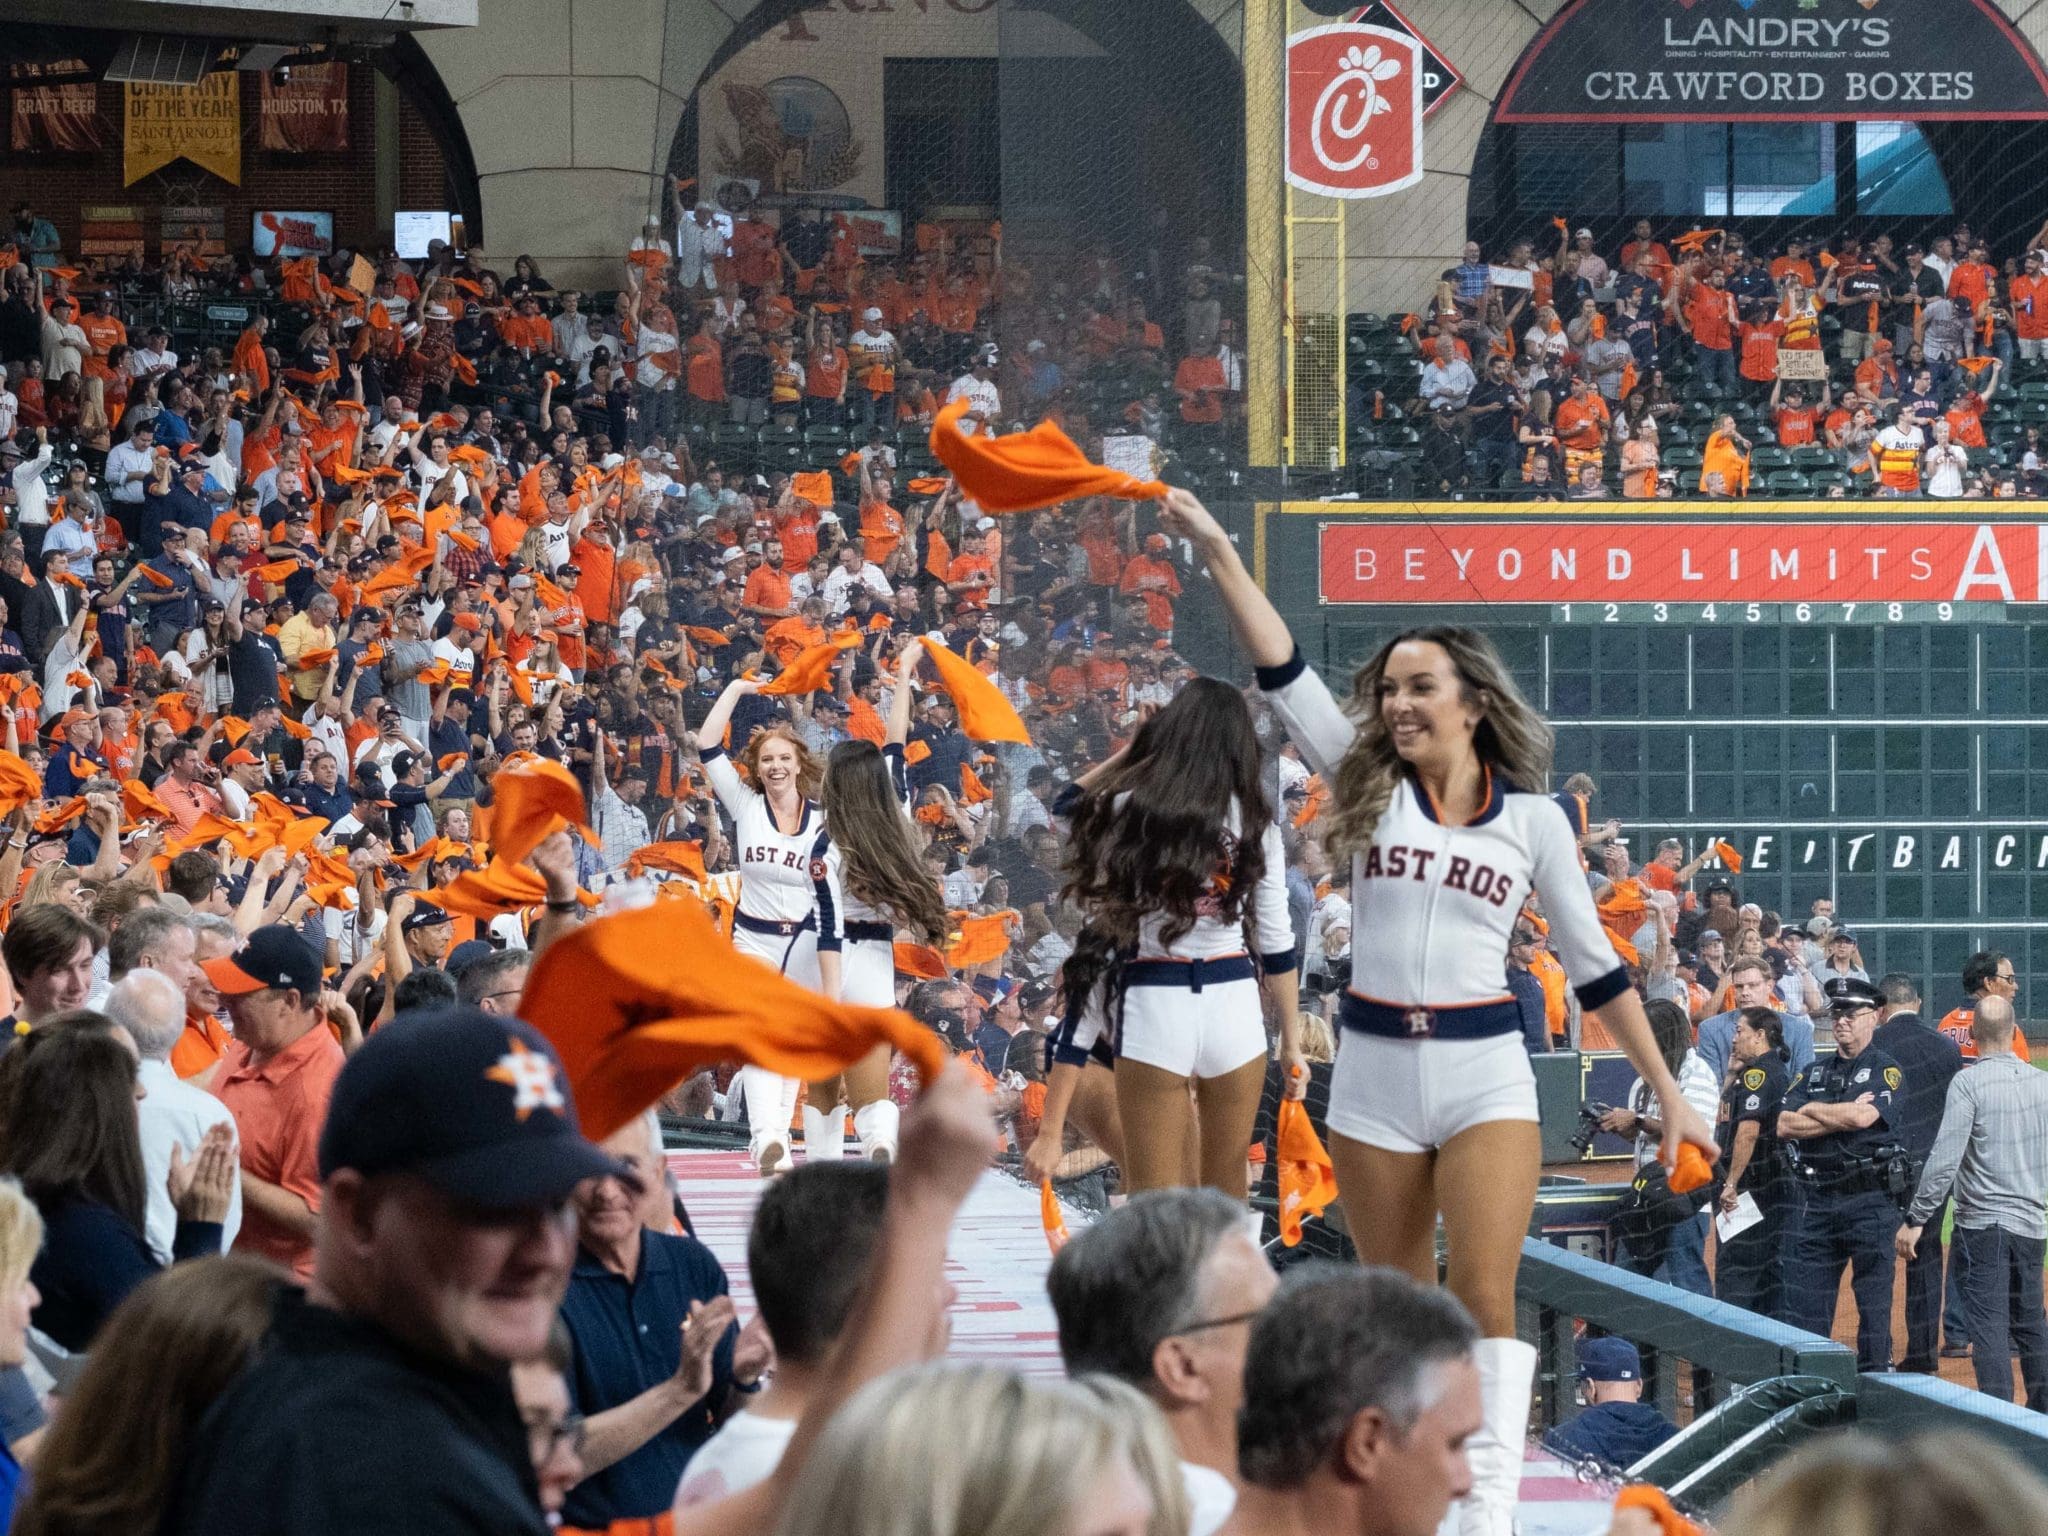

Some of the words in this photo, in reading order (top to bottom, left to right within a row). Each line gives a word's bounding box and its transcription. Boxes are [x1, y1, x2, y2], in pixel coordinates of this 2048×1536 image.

[1665, 17, 1890, 47] LANDRY'S
[1665, 51, 1697, 59] DINING
[1704, 51, 1762, 59] HOSPITALITY
[1771, 51, 1847, 59] ENTERTAINMENT
[1854, 51, 1890, 59] GAMING
[1585, 71, 1825, 101] CRAWFORD
[1845, 71, 1974, 101] BOXES
[17, 99, 60, 114] CRAFT
[62, 99, 96, 114] BEER
[131, 100, 150, 118] OF
[154, 100, 186, 118] THE
[189, 100, 233, 118] YEAR
[331, 99, 348, 114] TX
[1354, 547, 1632, 581] BEYOND
[1681, 547, 1932, 581] LIMITS
[1561, 604, 1572, 622] 1
[1604, 604, 1619, 622] 2
[1654, 604, 1668, 622] 3
[1702, 604, 1717, 622] 4
[1746, 604, 1762, 622] 5
[1796, 604, 1811, 622] 6
[1843, 604, 1855, 622] 7
[1888, 604, 1904, 622] 8
[1937, 604, 1953, 622] 9
[745, 846, 804, 871] ASTRO
